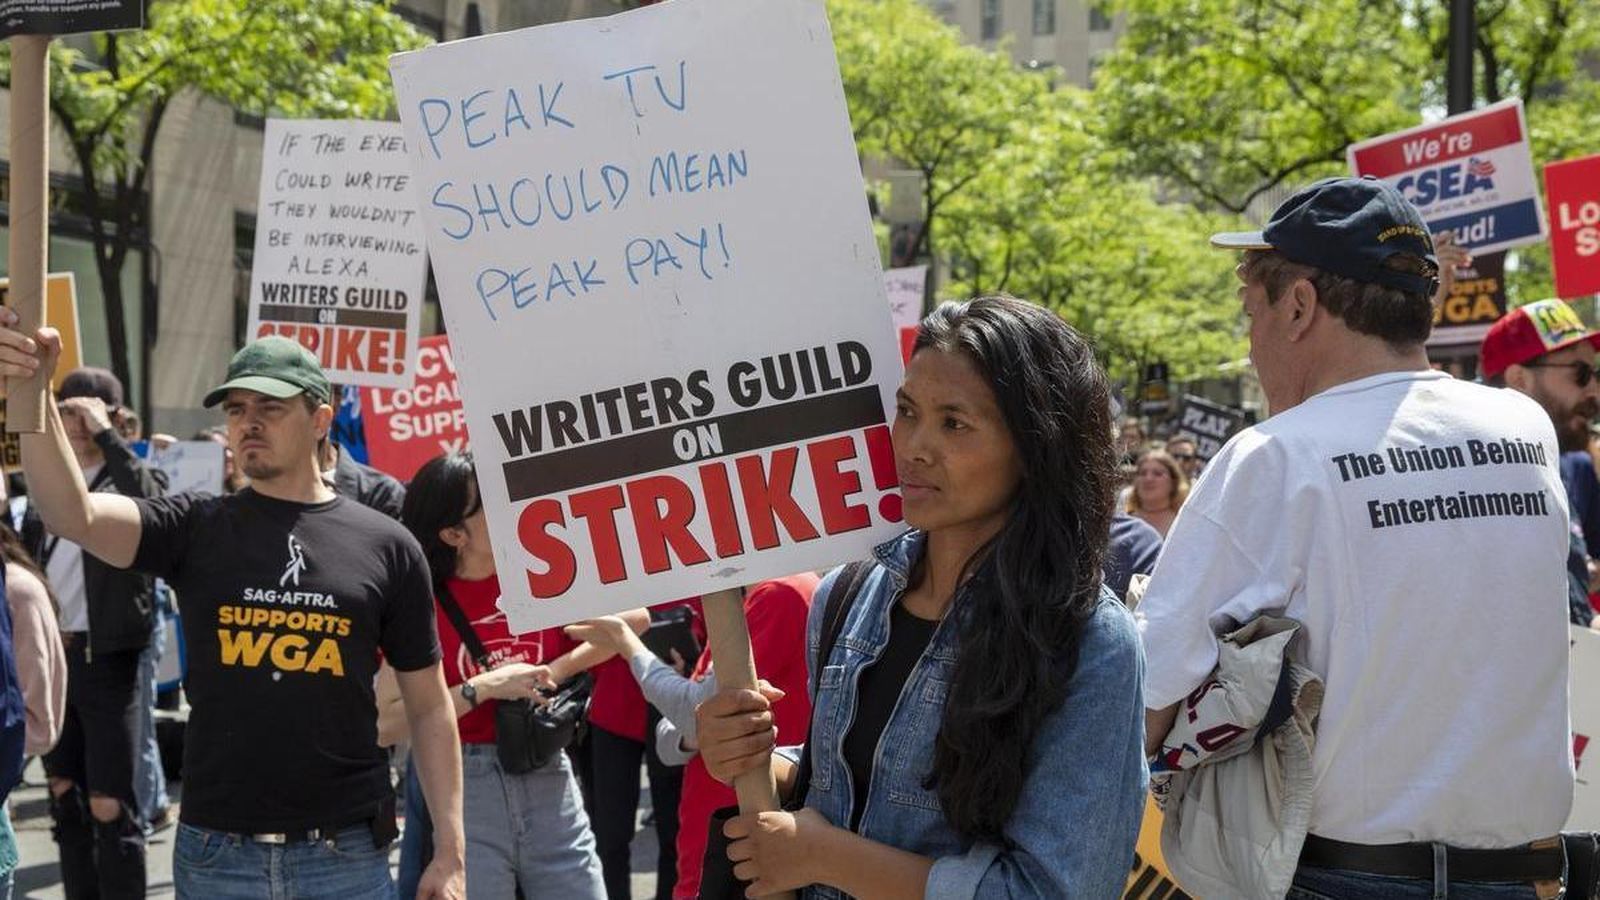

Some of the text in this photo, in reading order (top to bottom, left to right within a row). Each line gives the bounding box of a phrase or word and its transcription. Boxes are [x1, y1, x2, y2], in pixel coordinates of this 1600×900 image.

[419, 60, 685, 160] PEAK TV
[279, 132, 300, 156] IF
[312, 133, 346, 155] THE
[1402, 131, 1473, 165] We're
[275, 169, 410, 192] COULD WRITE
[432, 149, 748, 239] SHOULD MEAN
[268, 201, 317, 219] THEY
[269, 230, 420, 256] BE INTERVIEWING
[476, 223, 731, 321] PEAK PAY!
[261, 282, 408, 311] WRITERS GUILD
[318, 307, 338, 324] ON
[494, 340, 872, 457] WRITERS GUILD
[672, 422, 724, 461] ON
[1332, 438, 1547, 482] The Union Behind
[517, 424, 905, 599] STRIKE!
[1368, 489, 1549, 529] Entertainment
[218, 605, 352, 637] SUPPORTS
[218, 629, 345, 677] WGA
